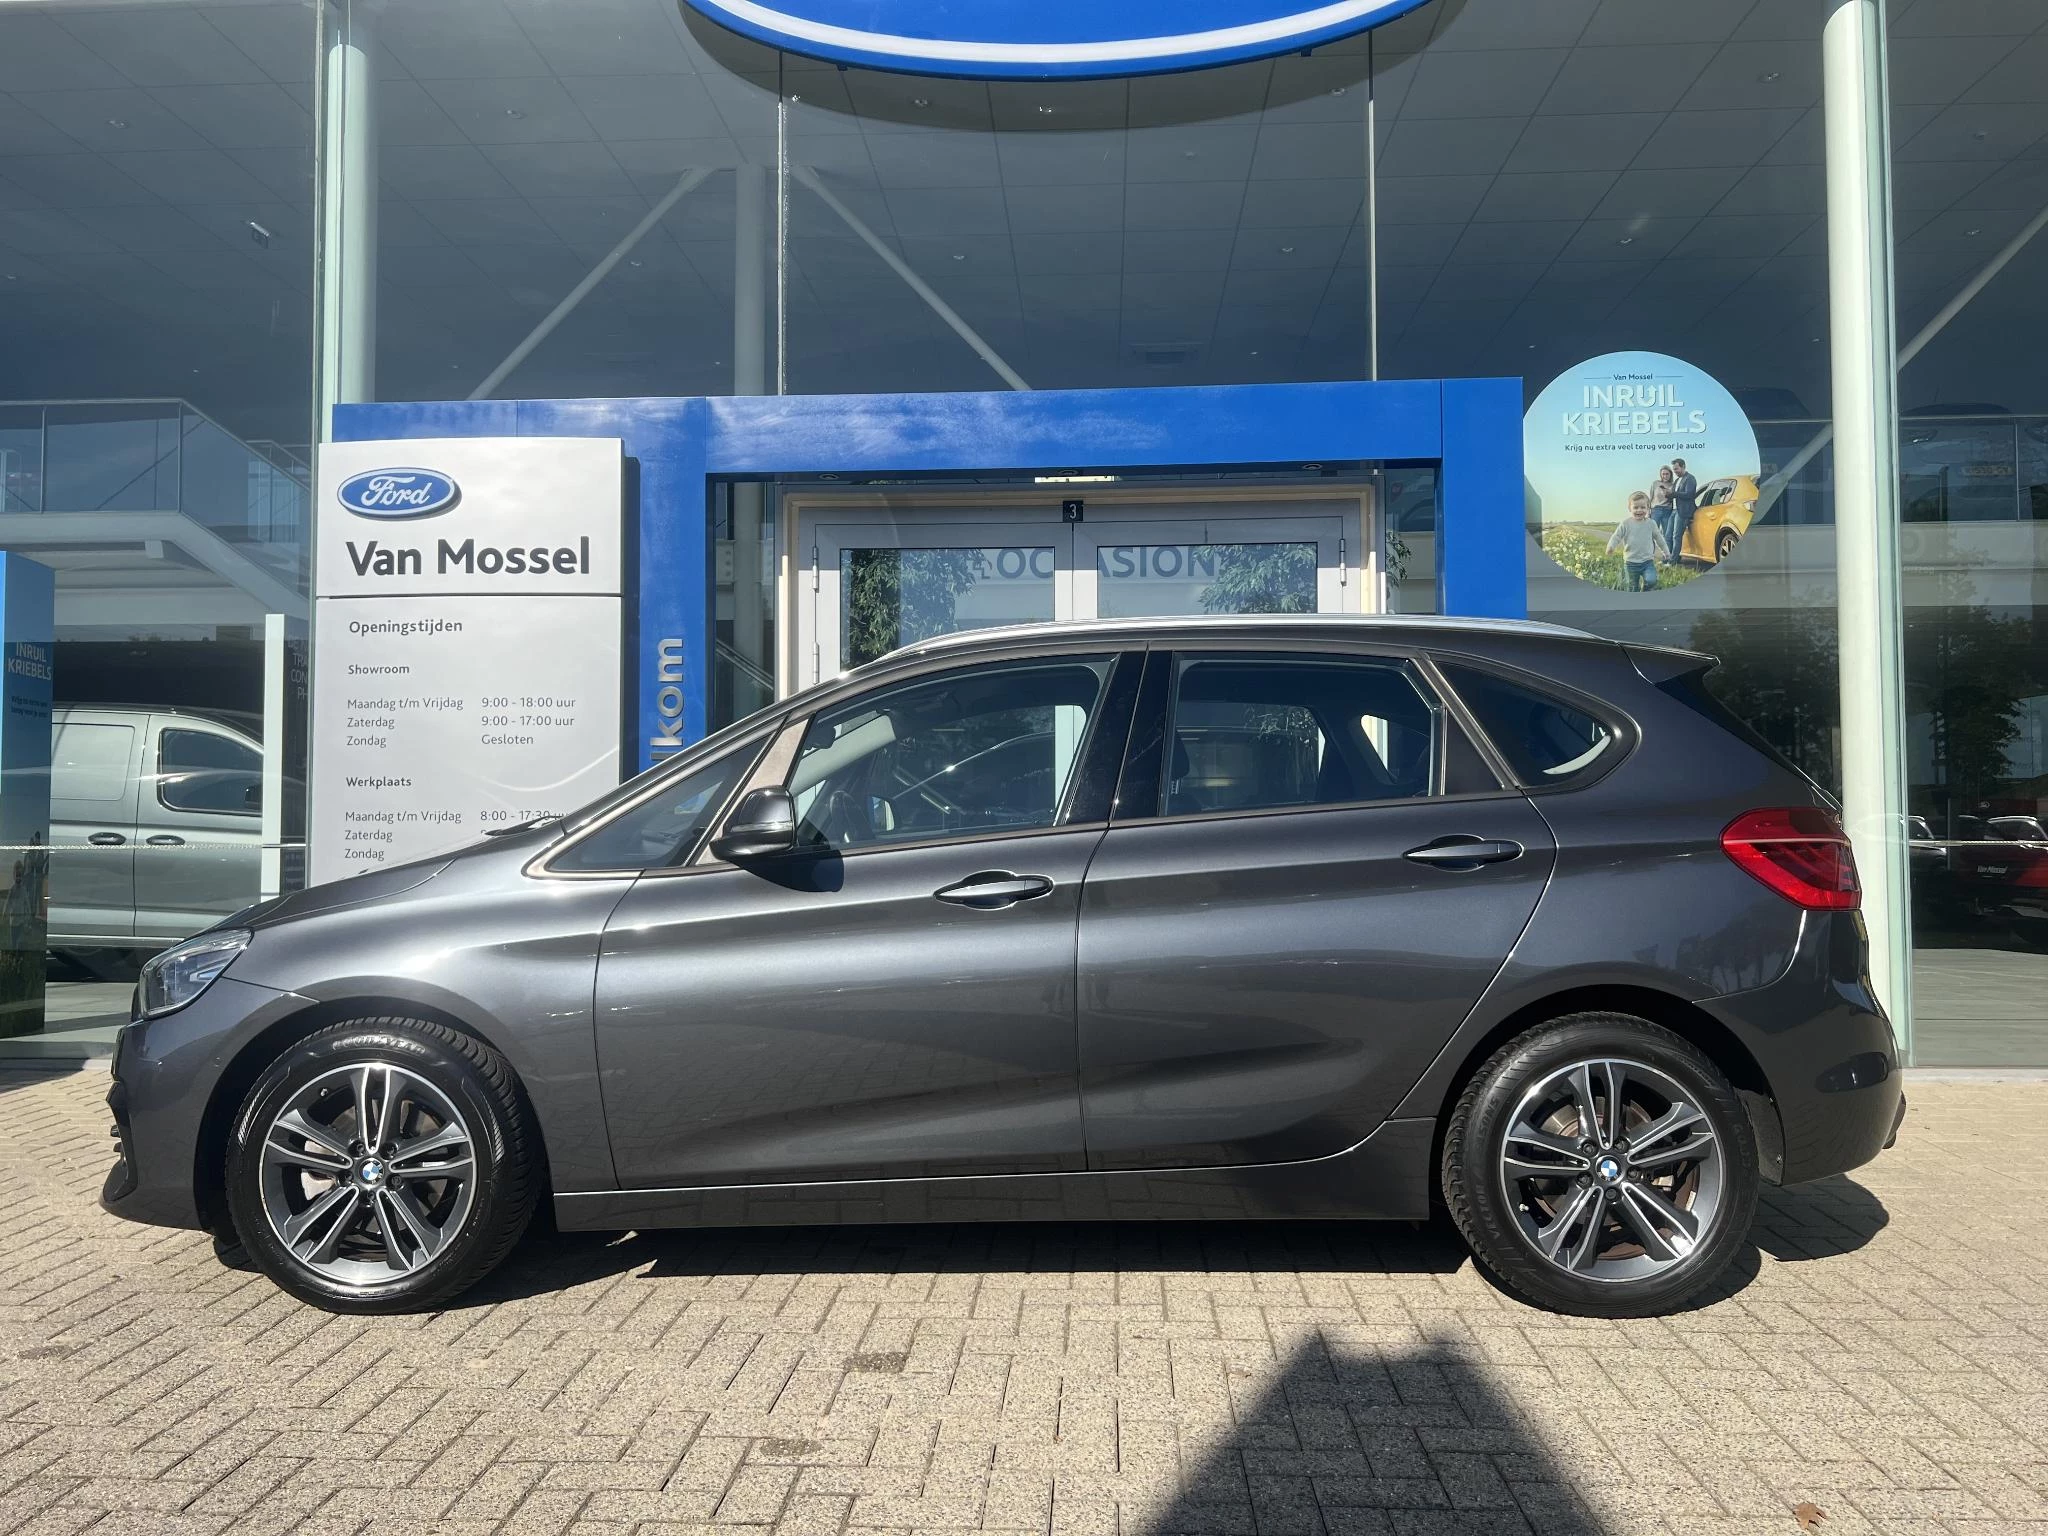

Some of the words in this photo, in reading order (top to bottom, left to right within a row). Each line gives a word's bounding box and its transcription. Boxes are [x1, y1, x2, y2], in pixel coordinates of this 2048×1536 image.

[1583, 384, 1685, 408] INRUIL
[1562, 410, 1707, 436] KRIEBELS
[1565, 444, 1583, 452] Krijg
[1635, 444, 1656, 452] terug
[1676, 443, 1684, 451] je
[360, 475, 431, 507] Ford
[1068, 503, 1077, 520] 3
[346, 540, 422, 576] Van
[437, 536, 590, 575] Mossel
[349, 619, 463, 636] Openingstijden
[16, 640, 48, 663] INRUIL
[8, 657, 53, 680] KRIEBELS
[348, 663, 410, 675] Showroom
[347, 699, 396, 711] Maandag
[399, 698, 420, 709] t/m
[423, 698, 464, 711] Vrijdag
[481, 697, 508, 708] 9:00
[519, 697, 553, 708] 18:00
[556, 699, 576, 708] uur
[347, 717, 395, 730] Zaterdag
[481, 716, 508, 726] 9:00
[519, 715, 552, 726] 17:00
[555, 717, 575, 726] uur
[346, 735, 387, 748] Zondag
[481, 734, 534, 745] Gesloten
[346, 776, 412, 789] Werkplaats
[345, 811, 394, 824] Maandag
[397, 811, 418, 821] t/m
[421, 810, 462, 824] Vrijdag
[480, 810, 507, 821] 8:00
[344, 829, 393, 843] Zaterdag
[344, 848, 385, 862] Zondag
